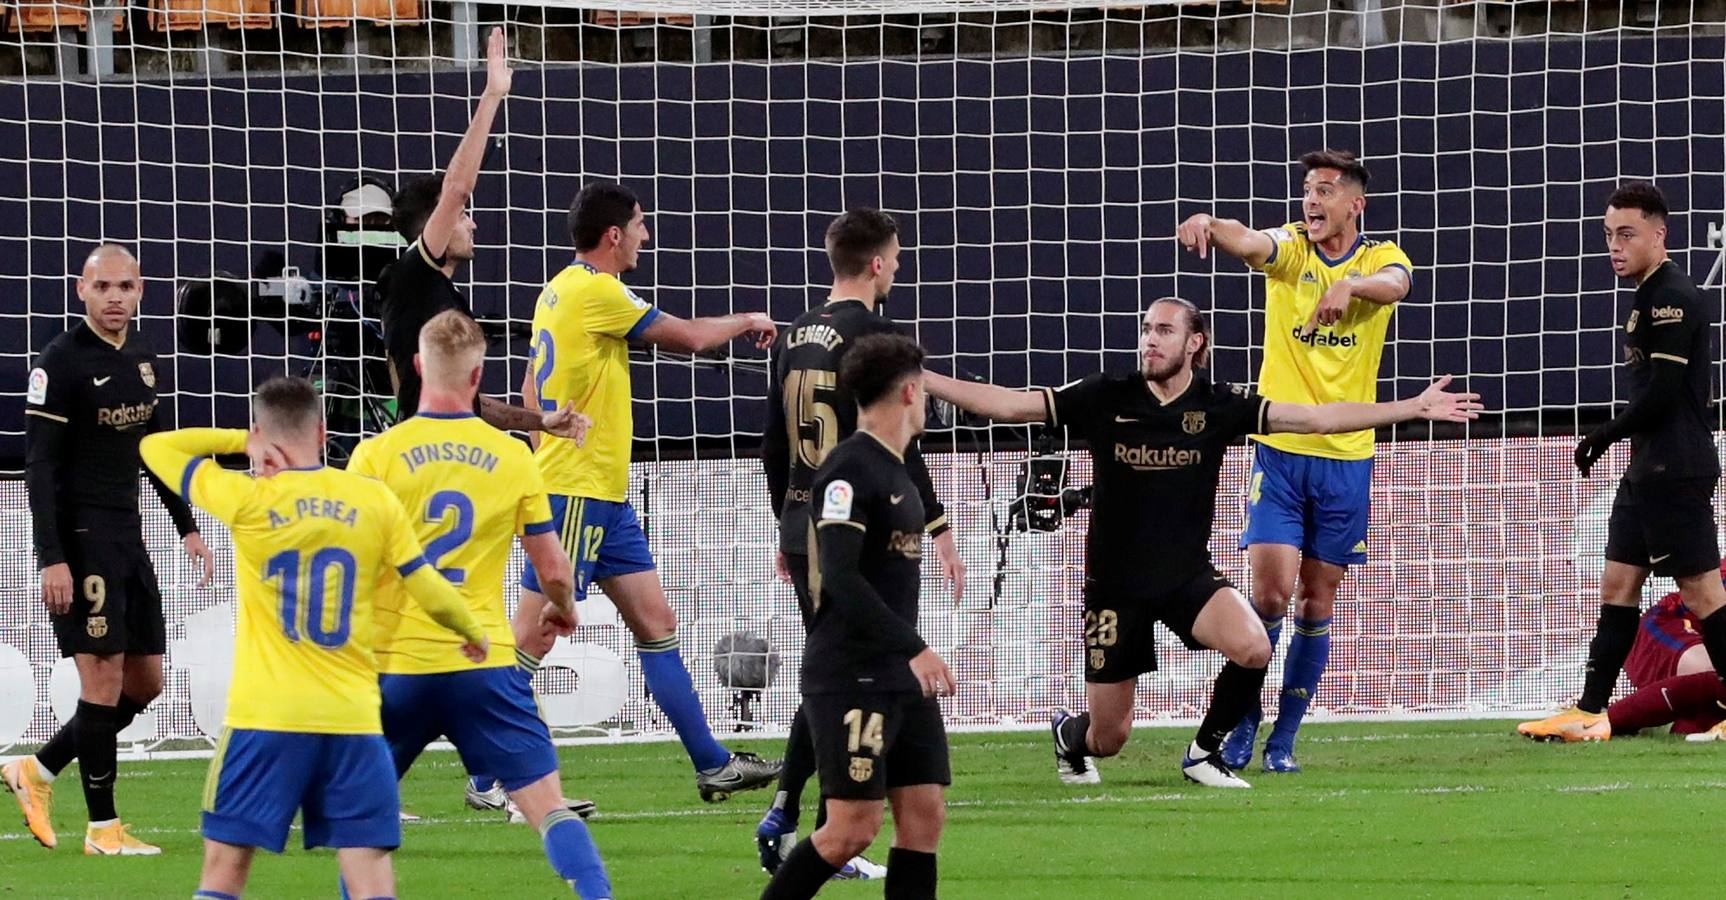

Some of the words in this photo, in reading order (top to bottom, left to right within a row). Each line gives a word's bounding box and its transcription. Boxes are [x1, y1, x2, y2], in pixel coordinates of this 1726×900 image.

[1652, 305, 1684, 318] beko
[787, 324, 844, 351] LENGLET
[1292, 325, 1357, 347] dafabet
[98, 402, 153, 426] Rakute
[783, 369, 838, 470] 15
[401, 441, 499, 473] JØNSSON
[1114, 442, 1201, 466] Rakuten
[268, 509, 290, 528] A.
[295, 497, 357, 527] PEREA
[422, 489, 474, 587] 2
[583, 525, 604, 562] 12
[83, 574, 106, 614] 9
[261, 546, 357, 649] 10
[843, 708, 884, 756] 14
